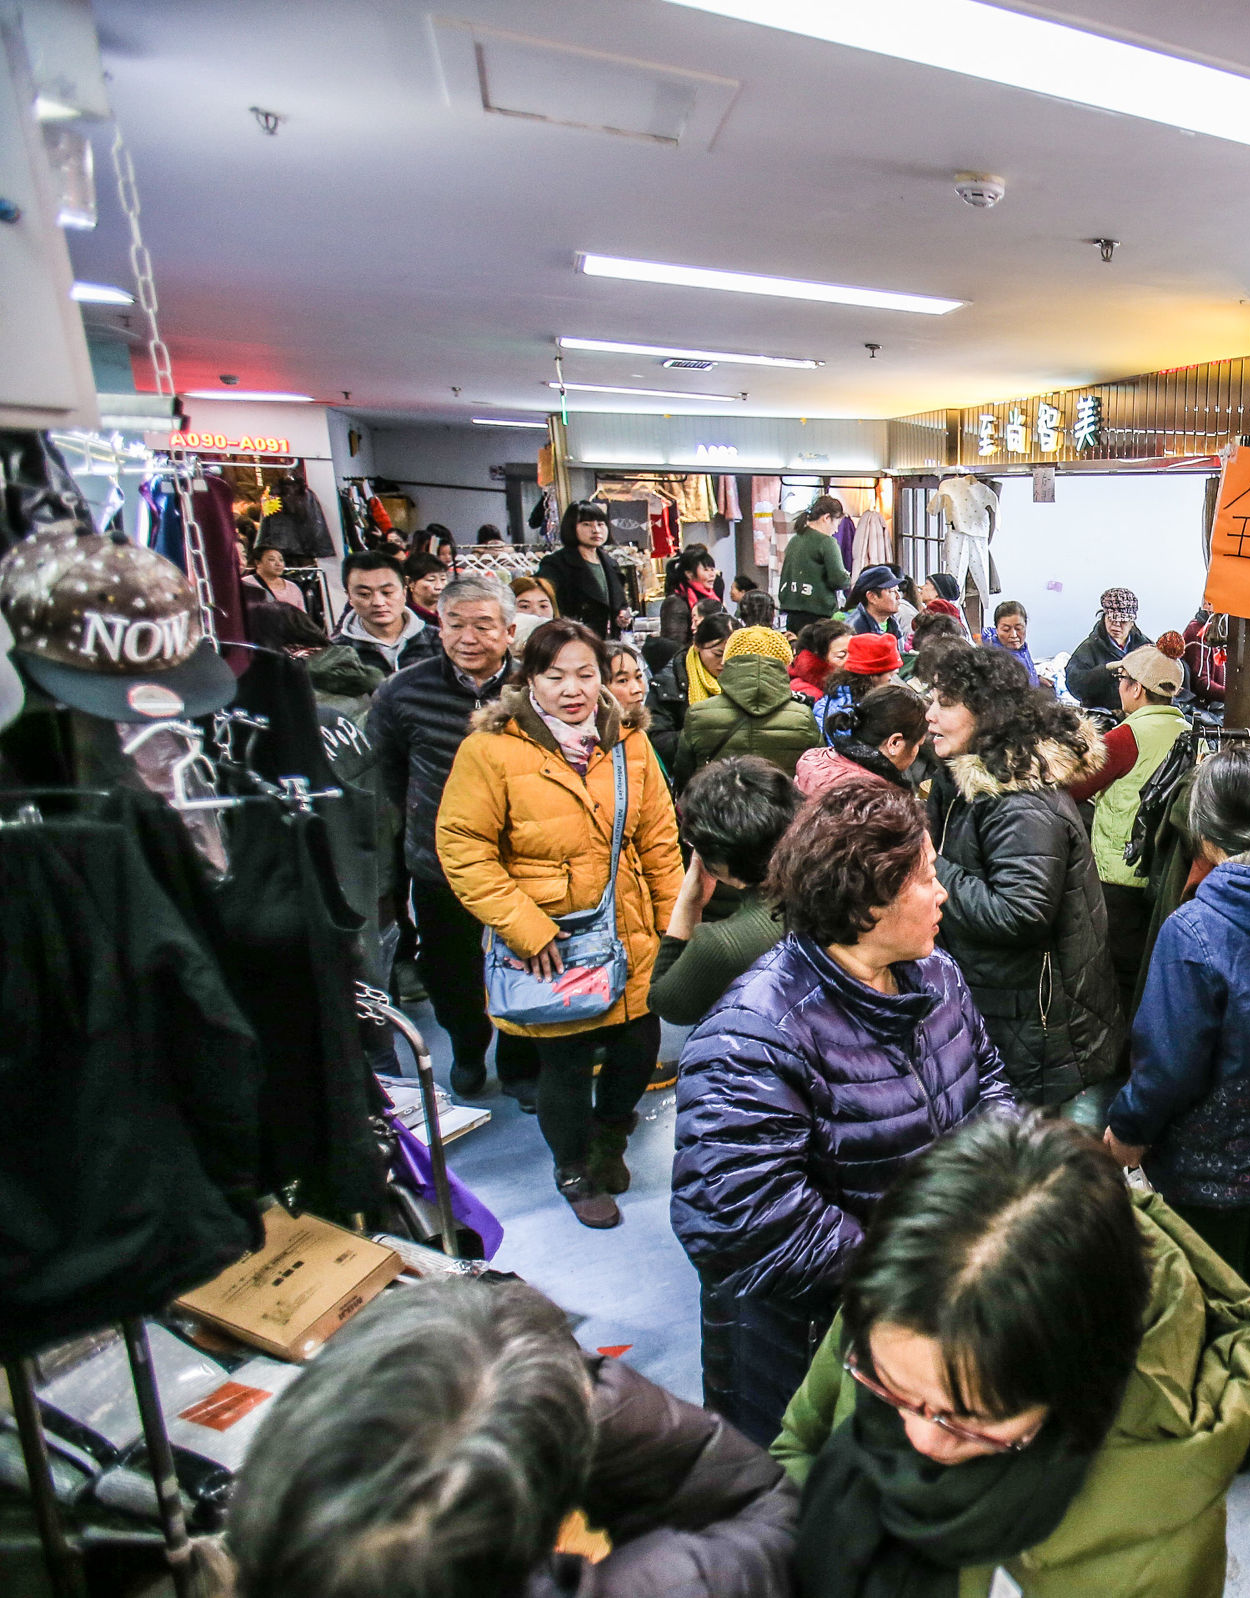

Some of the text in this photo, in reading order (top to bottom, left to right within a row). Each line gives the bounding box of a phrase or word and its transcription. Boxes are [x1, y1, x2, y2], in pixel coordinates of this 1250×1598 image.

[169, 430, 290, 453] A090-A091
[978, 394, 1100, 457] 至尚智美
[79, 610, 191, 663] NOW
